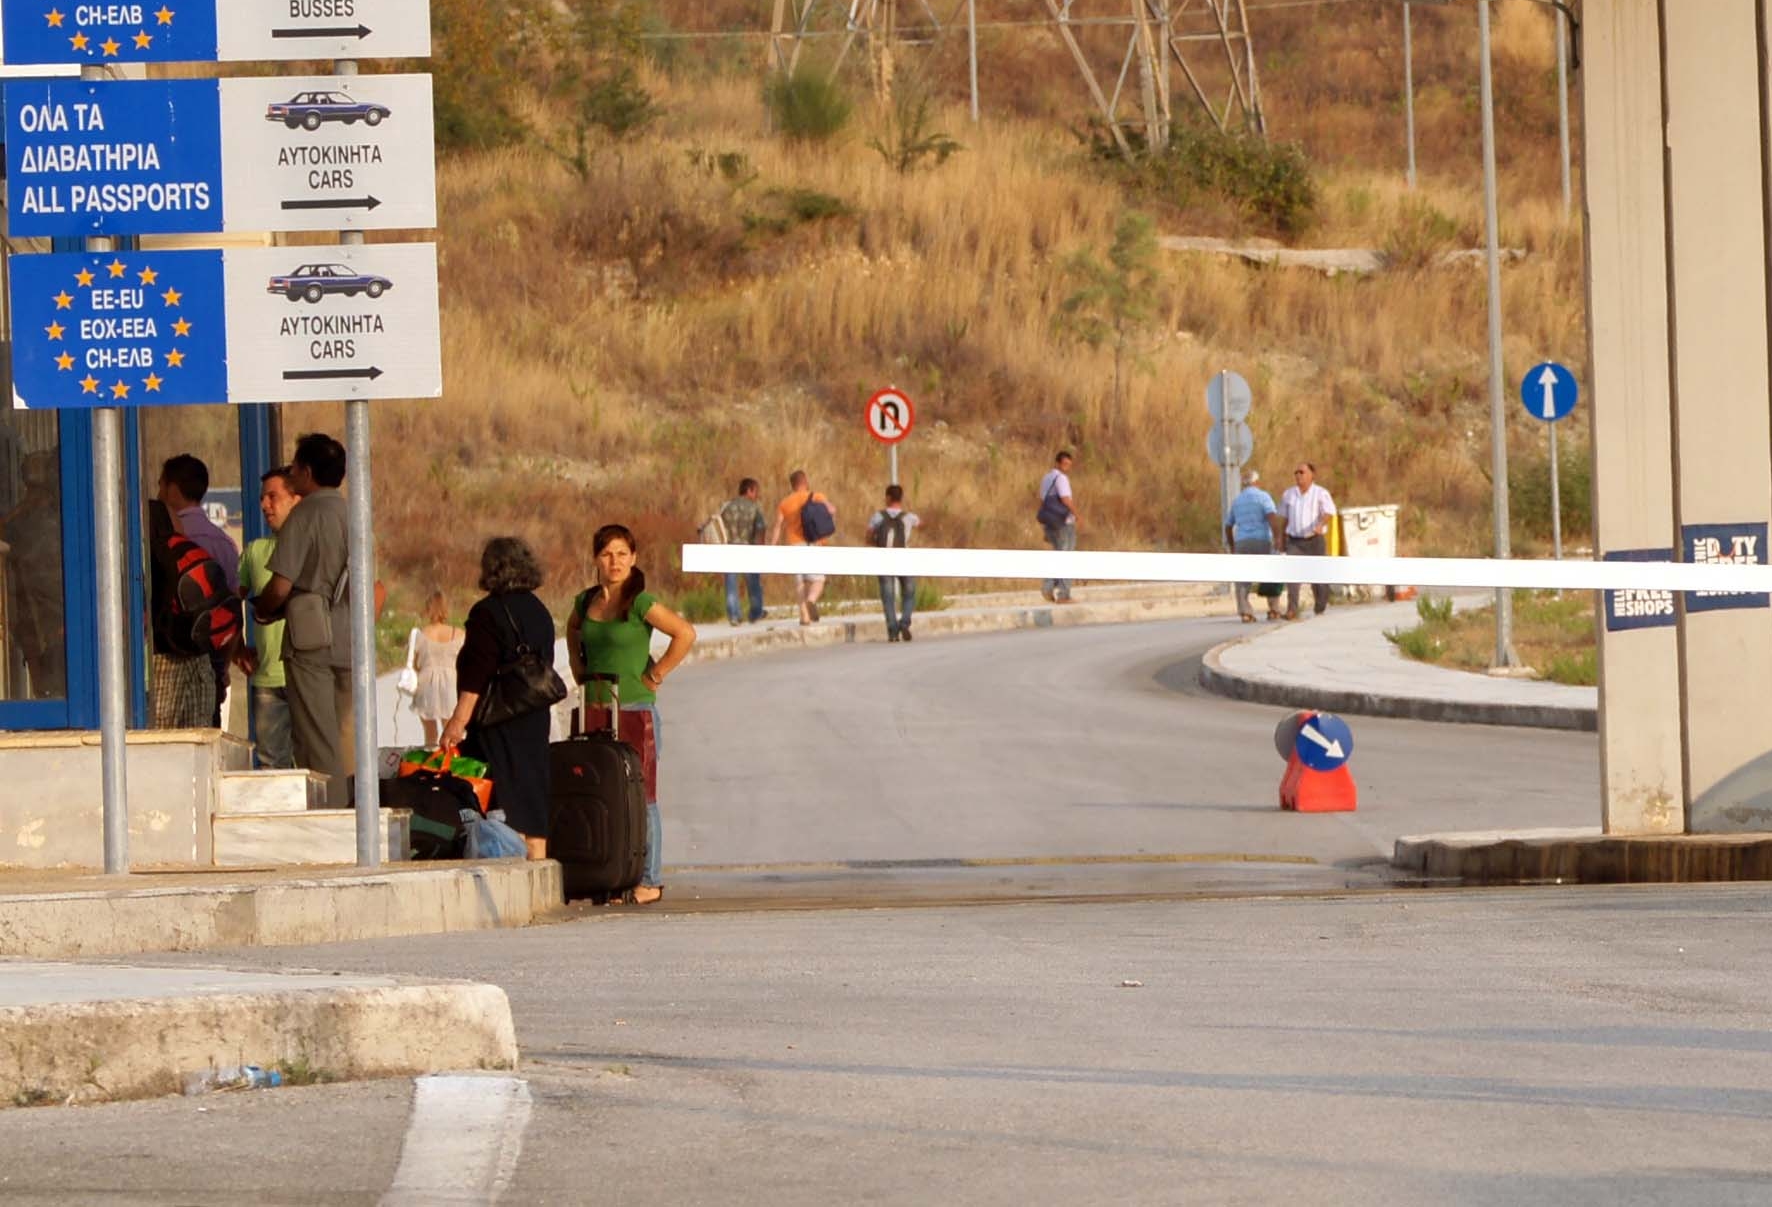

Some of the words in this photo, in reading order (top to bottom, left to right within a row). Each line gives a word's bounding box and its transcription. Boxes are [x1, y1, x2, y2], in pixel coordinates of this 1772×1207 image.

[76, 5, 143, 25] CH-ΕΛΒ
[20, 104, 68, 132] ΟΛΑ
[73, 103, 104, 131] ΤΑ
[21, 144, 160, 173] ΔΙΑΒΑΤΗΡΙΑ
[278, 145, 382, 166] ΑΥΤΟΚΙΝΗΤΑ
[308, 169, 353, 189] CARS
[22, 186, 65, 214] ALL
[71, 182, 209, 212] PASSPORTS
[91, 288, 144, 310] ΕΕ-EU
[80, 318, 157, 339] ΕΟΧ-EEA
[280, 315, 384, 336] ΑΥΤΟΚΙΝΗΤΑ
[86, 348, 153, 369] CH-ΕΛΒ
[310, 339, 355, 359] CARS
[1626, 600, 1674, 616] SHOPS
